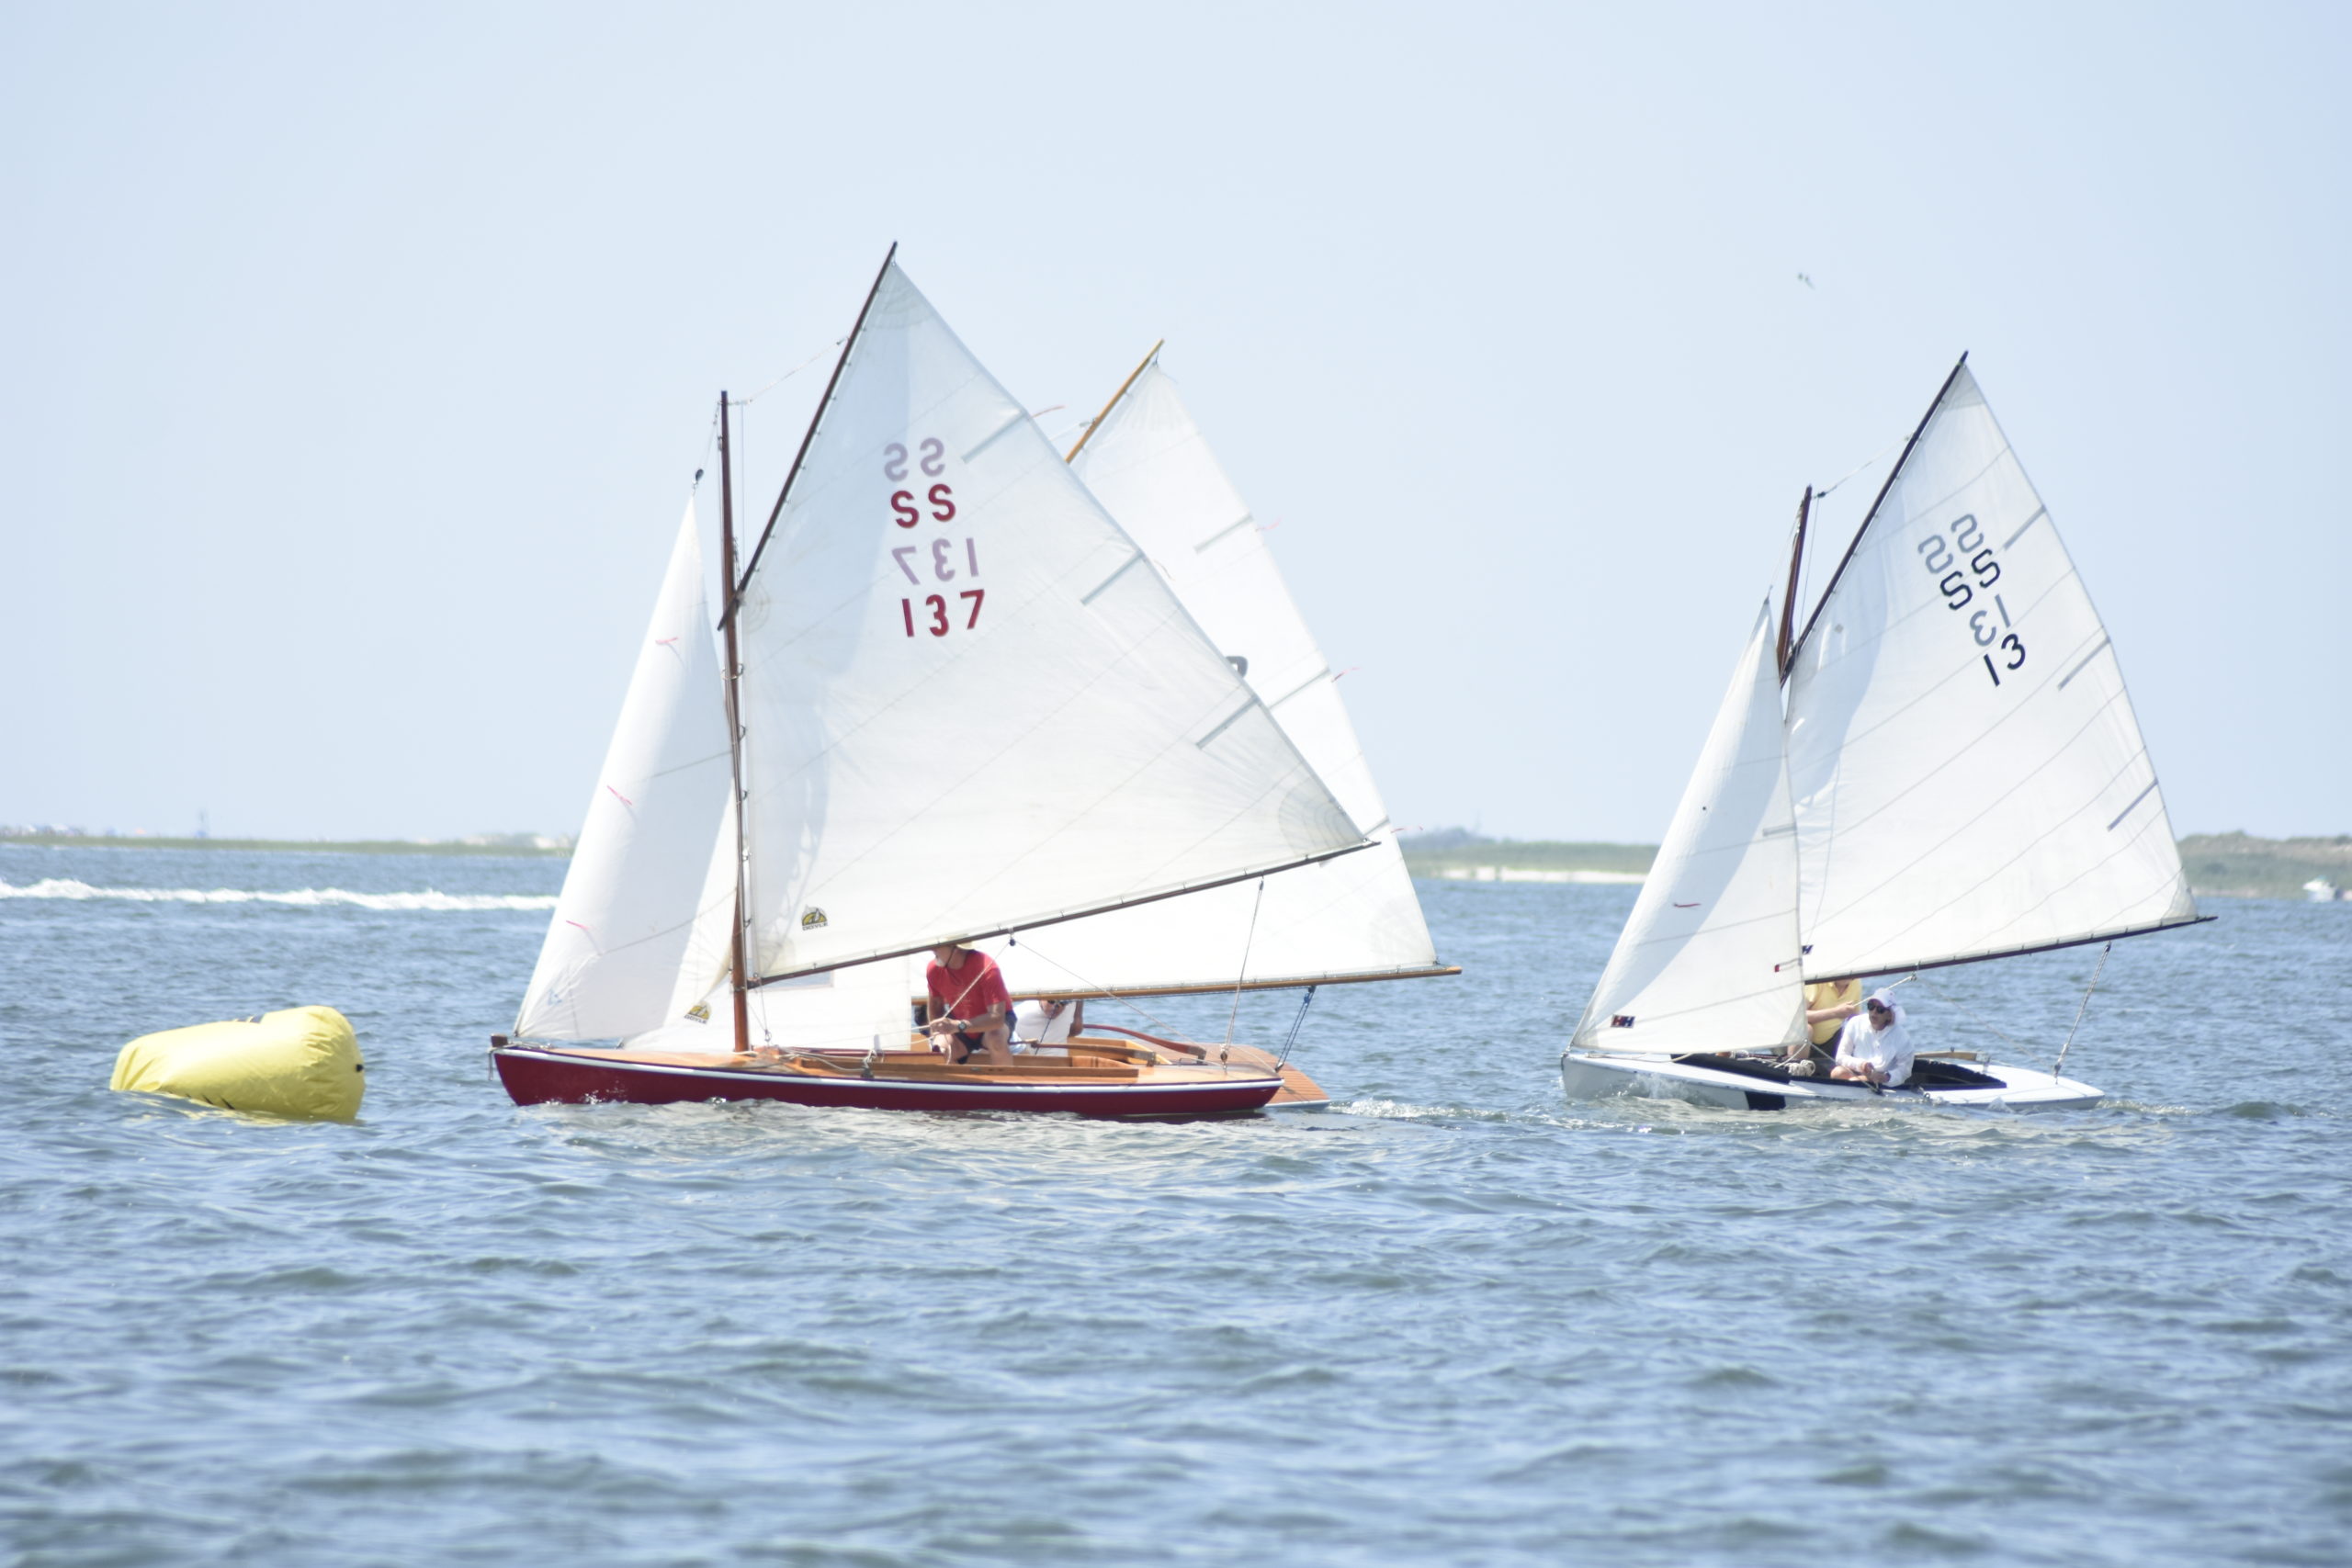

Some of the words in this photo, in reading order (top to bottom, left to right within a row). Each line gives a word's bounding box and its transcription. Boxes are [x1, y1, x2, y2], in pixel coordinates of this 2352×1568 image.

[890, 483, 956, 529] SS
[1939, 548, 2001, 611] SS
[901, 589, 985, 637] 137
[1983, 633, 2026, 687] 13
